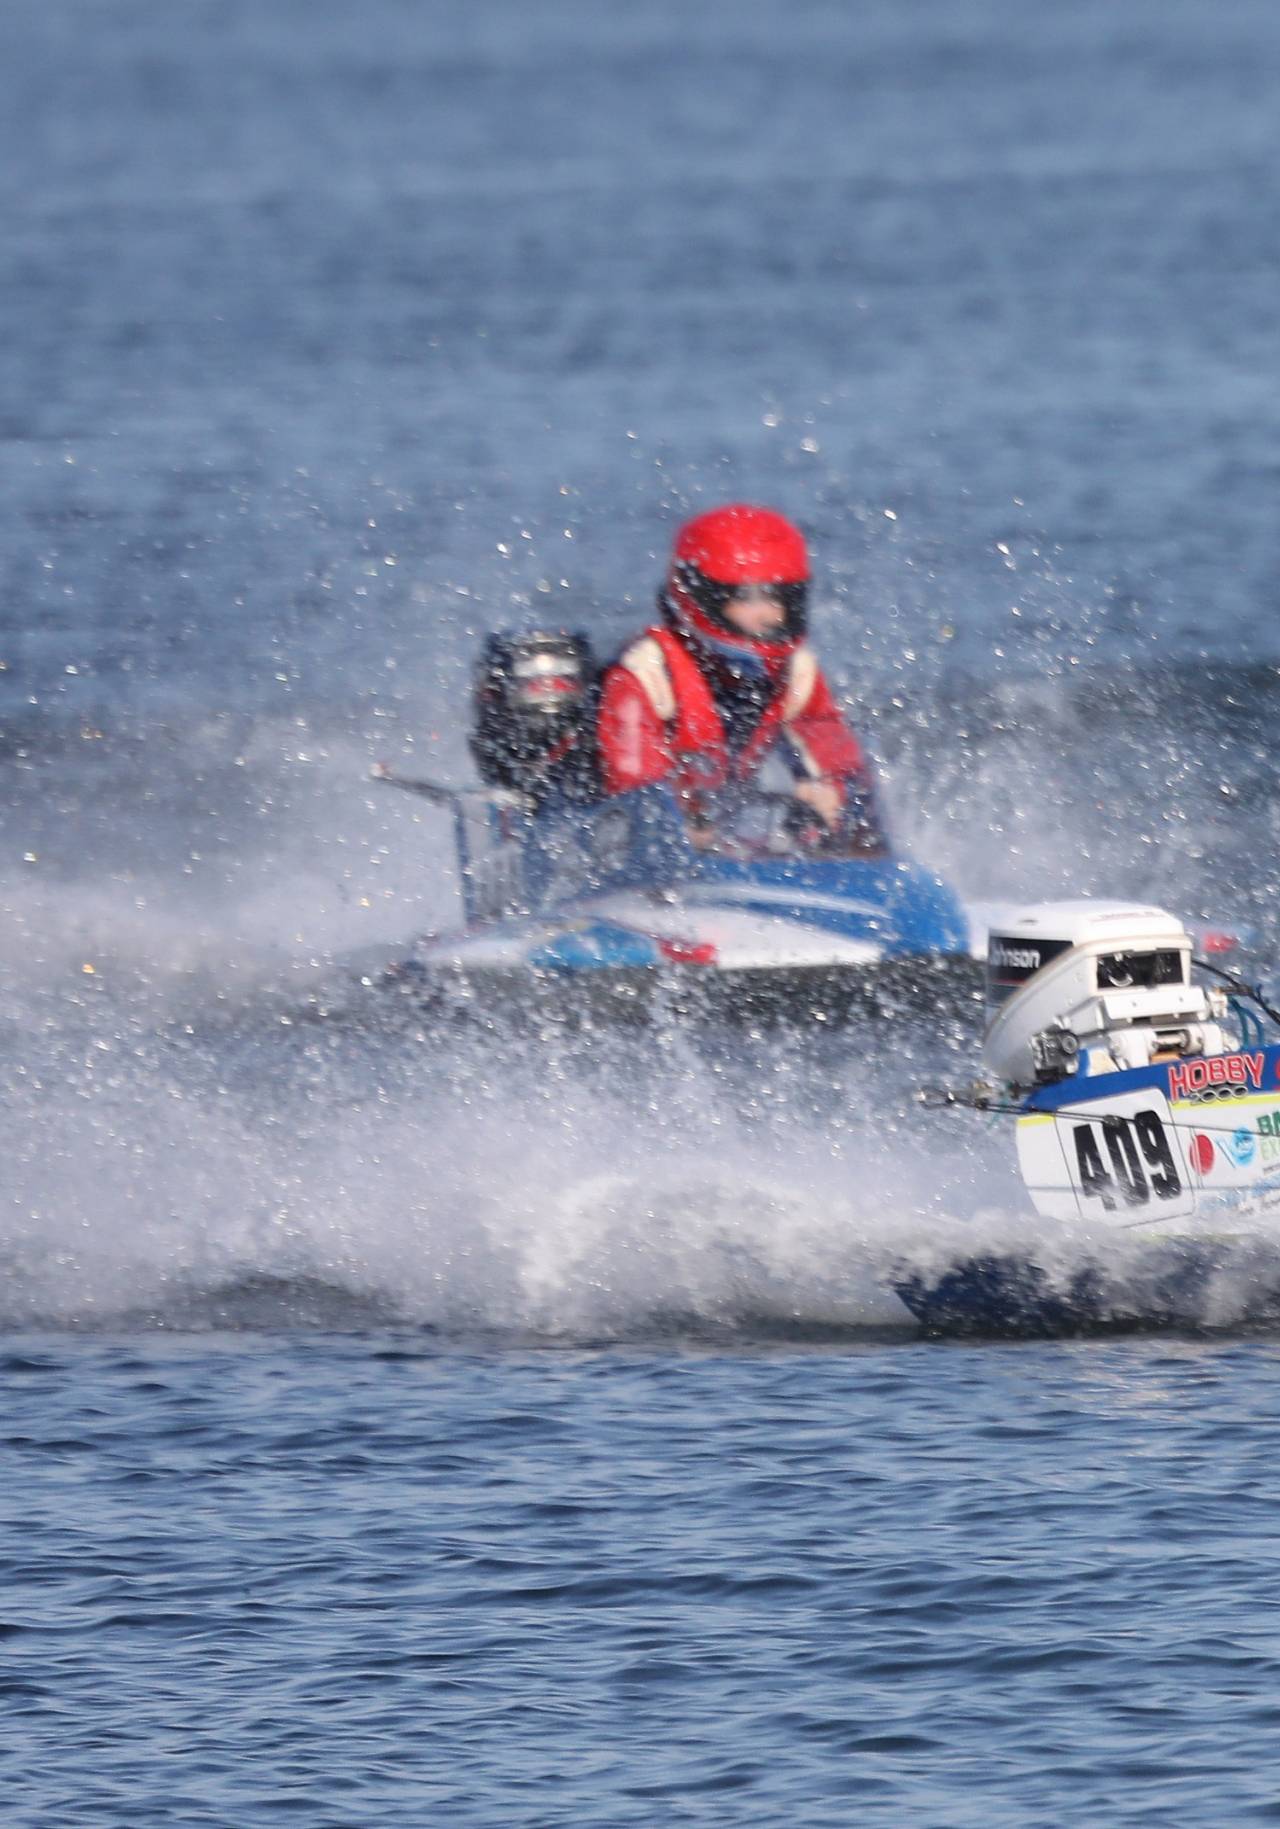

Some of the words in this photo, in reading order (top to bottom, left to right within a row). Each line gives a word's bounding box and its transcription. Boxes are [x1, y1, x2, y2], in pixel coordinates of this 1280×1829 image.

[989, 942, 1041, 969] ohnson
[1168, 1053, 1265, 1105] HOBBY
[1073, 1110, 1182, 1212] 409
